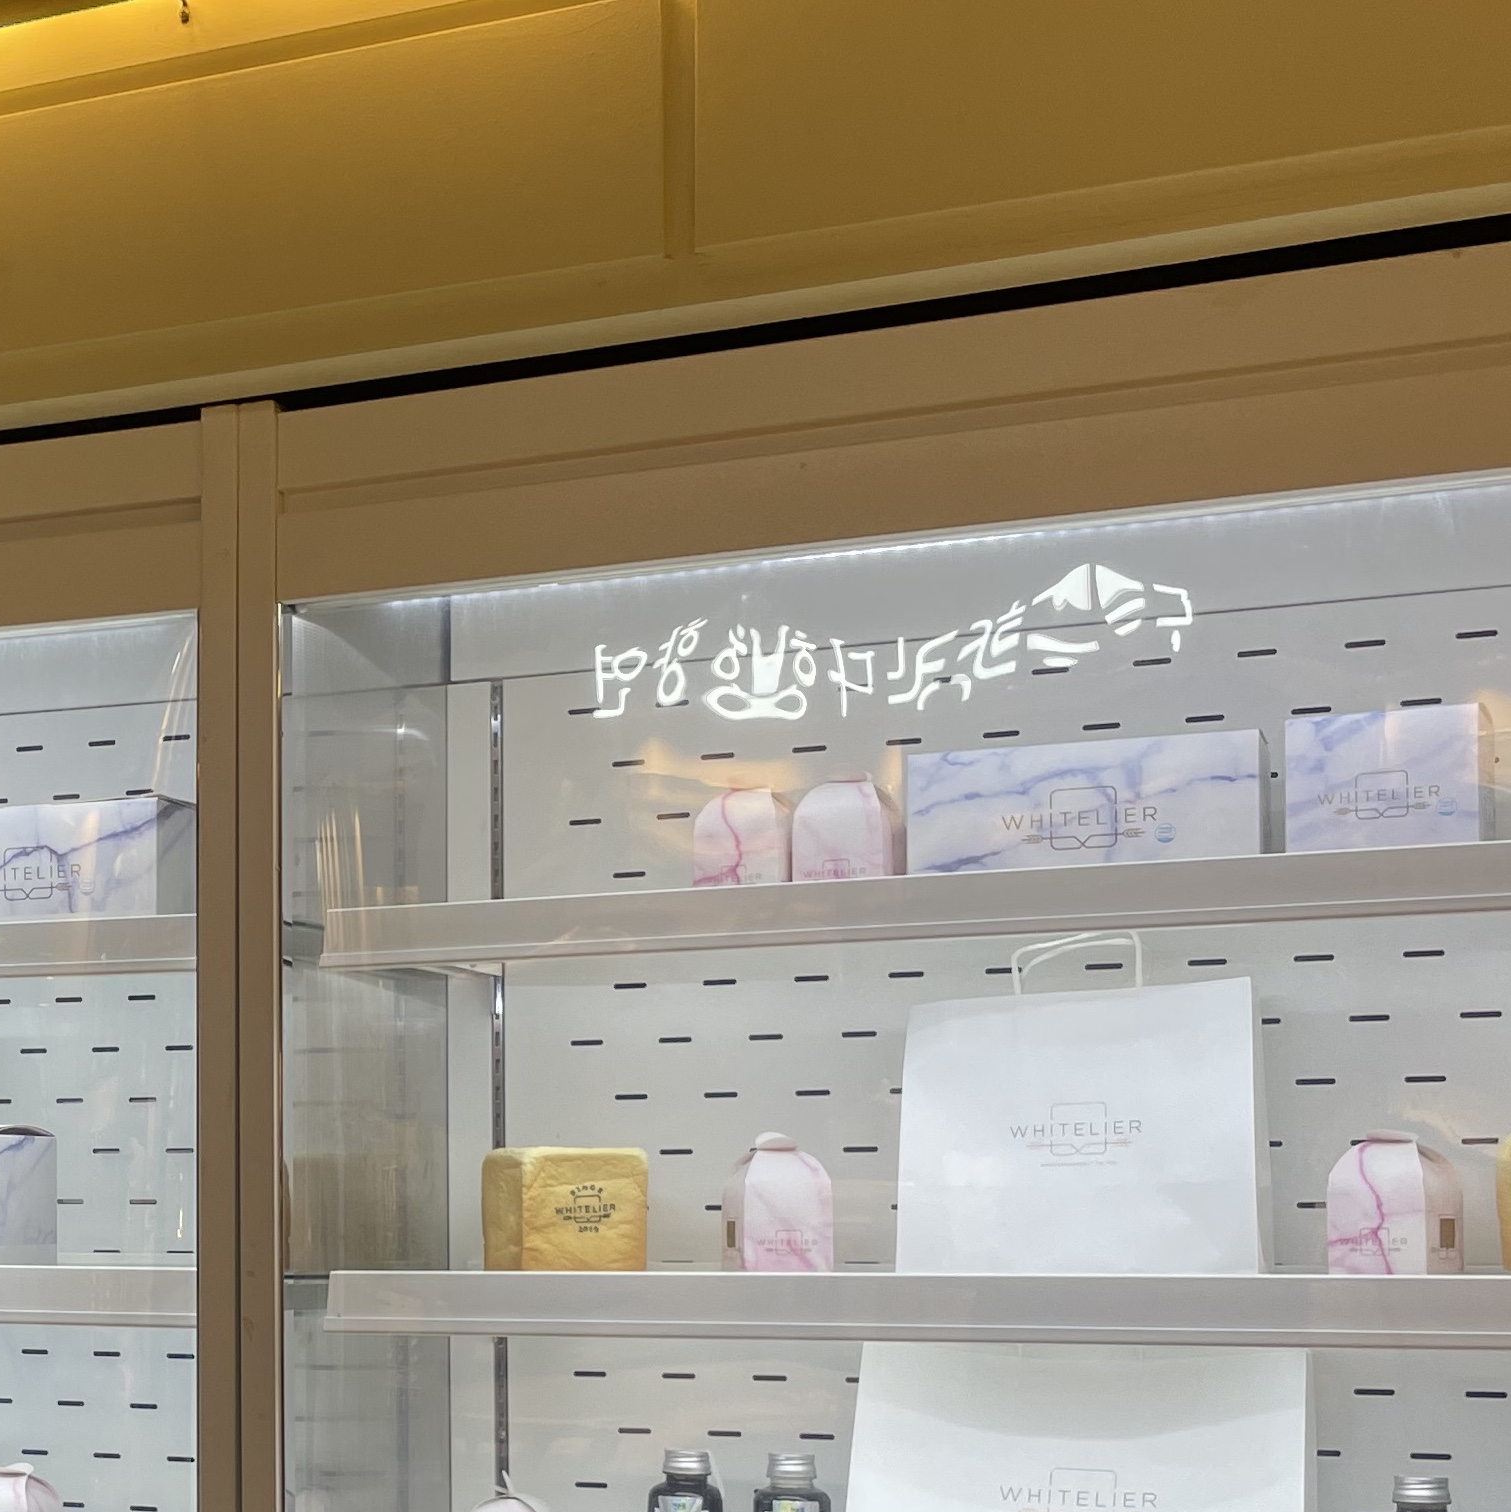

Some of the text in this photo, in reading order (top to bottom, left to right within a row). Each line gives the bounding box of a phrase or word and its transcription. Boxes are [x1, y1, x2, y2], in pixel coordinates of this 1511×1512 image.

[1317, 785, 1441, 806] WHITELIER
[1001, 806, 1159, 831] WHITELIER
[1009, 1119, 1143, 1139] WHITELIER
[554, 1203, 616, 1215] WHITELIER
[999, 1485, 1159, 1509] WHITELIER
